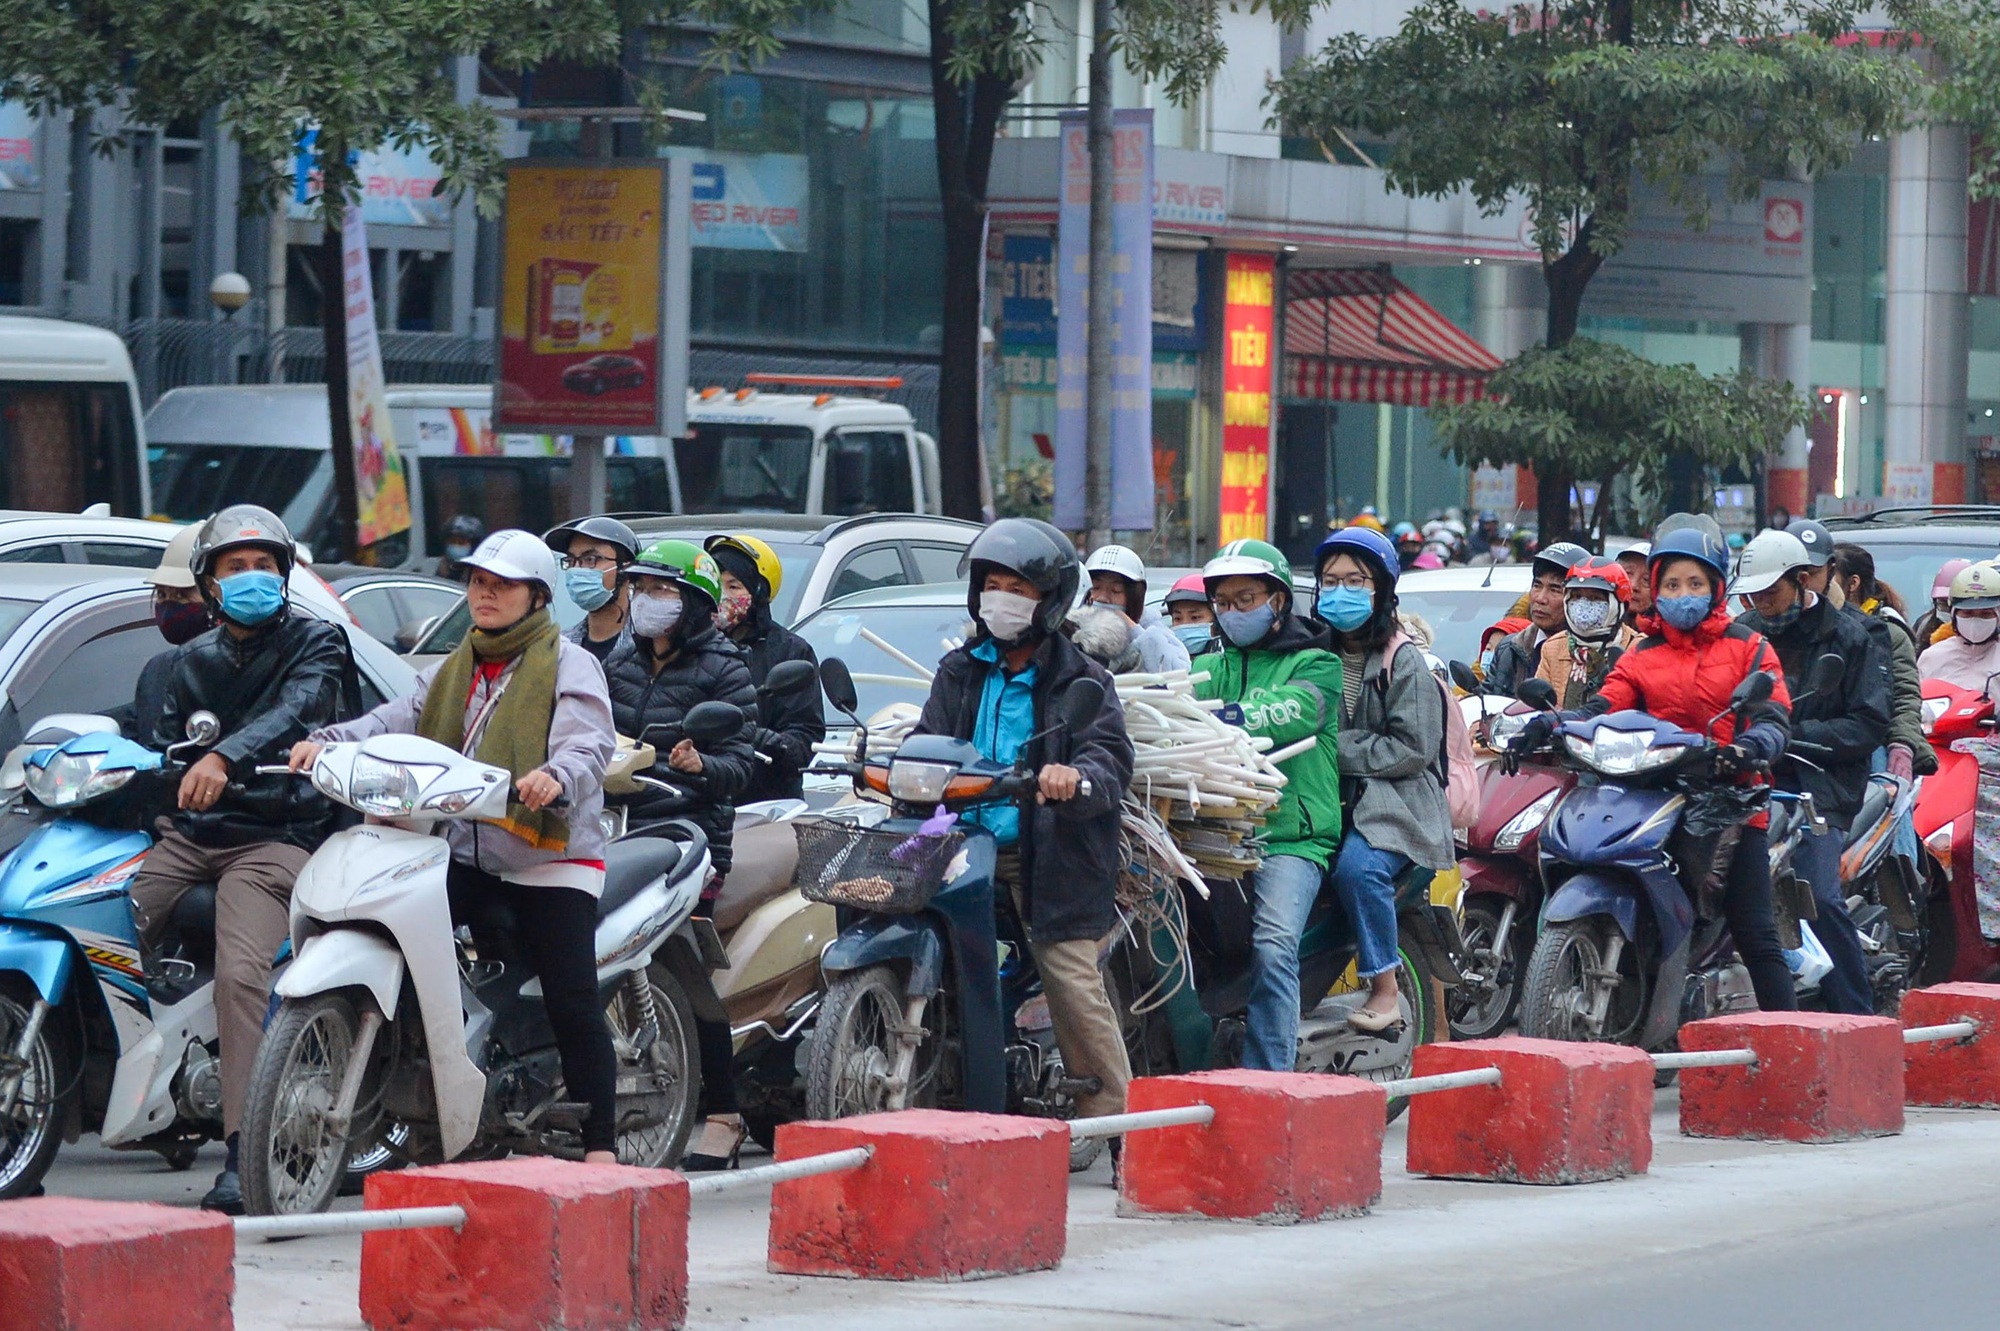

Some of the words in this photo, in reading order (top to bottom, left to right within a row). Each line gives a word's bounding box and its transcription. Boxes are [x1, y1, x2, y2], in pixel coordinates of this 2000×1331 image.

[732, 203, 799, 228] RIVER
[1166, 181, 1225, 210] RIVER
[1226, 262, 1273, 306] HÀNG
[1230, 323, 1267, 367] TIÊU
[1221, 445, 1267, 496] NHẬP
